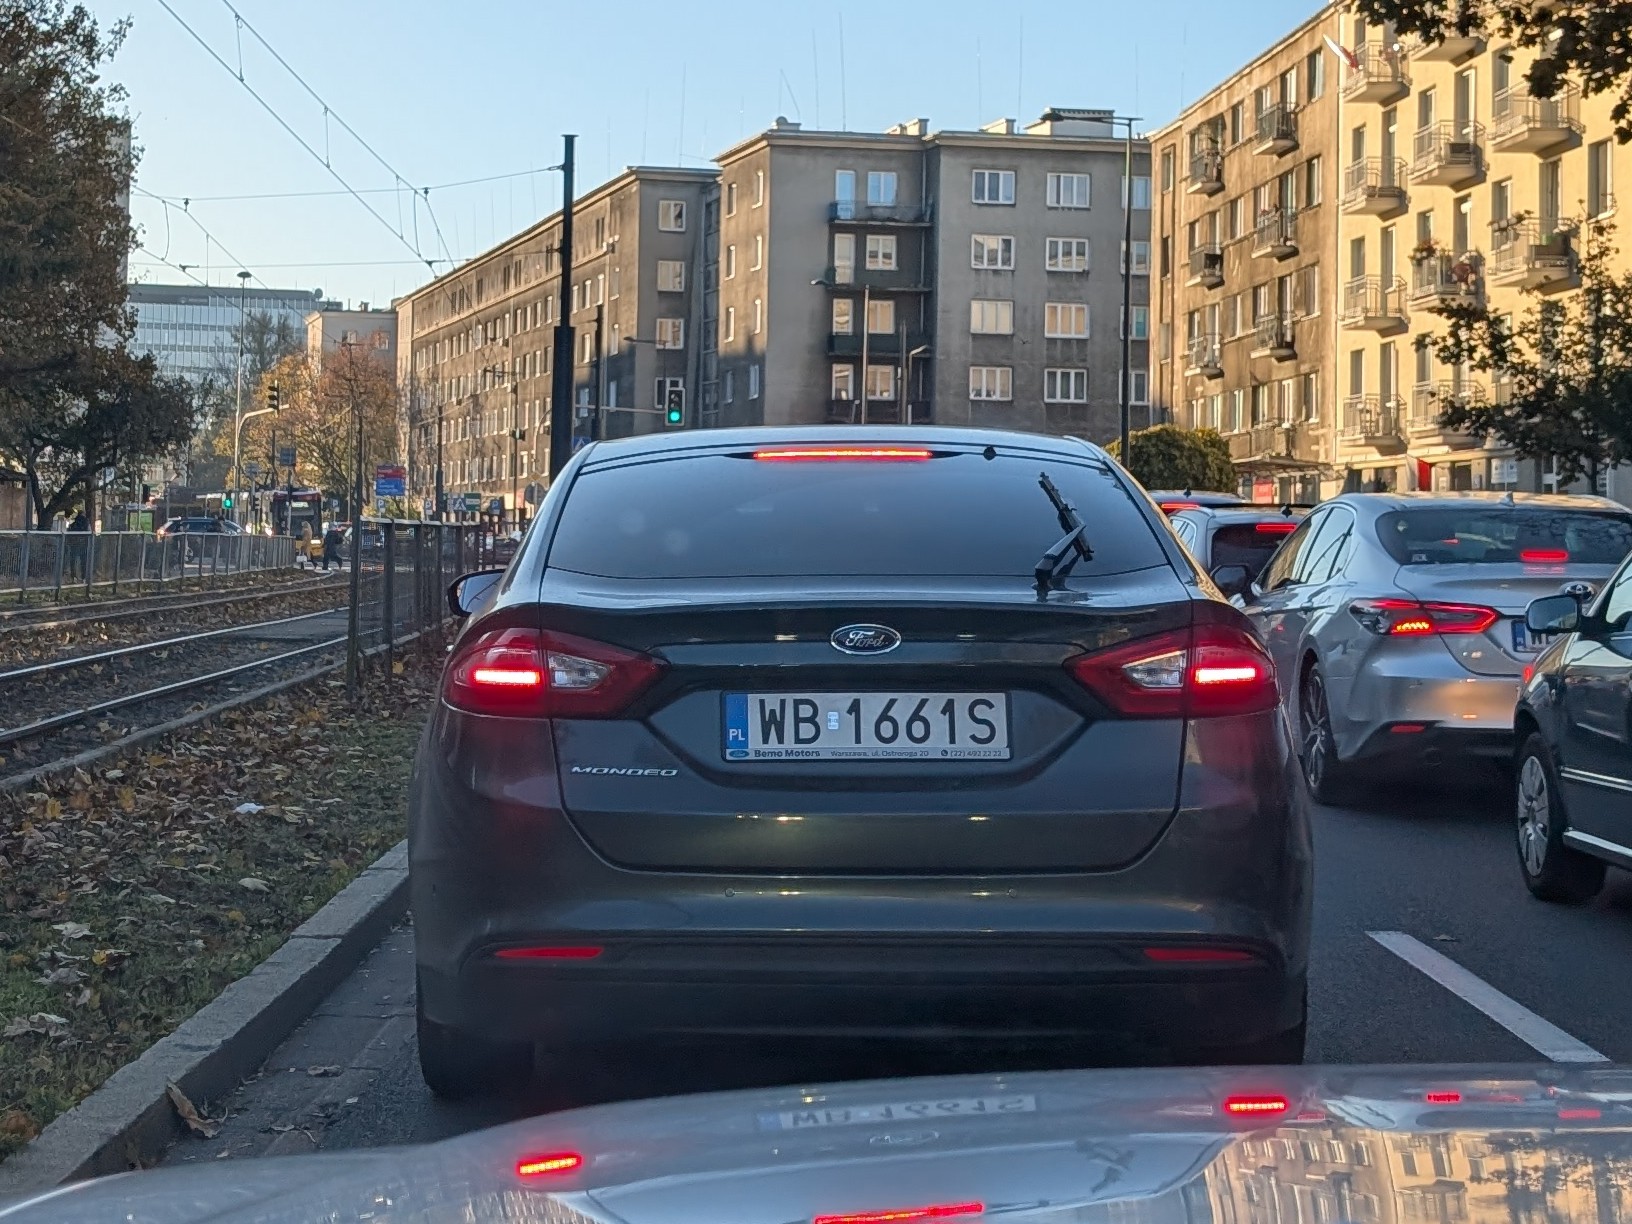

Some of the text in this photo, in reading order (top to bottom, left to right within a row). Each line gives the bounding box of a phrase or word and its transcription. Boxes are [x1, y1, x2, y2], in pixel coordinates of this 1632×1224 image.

[845, 630, 888, 647] Ford
[758, 697, 997, 745] WB 1661S
[728, 728, 746, 741] PL
[785, 749, 820, 757] Motors
[571, 765, 678, 777] MONDEO
